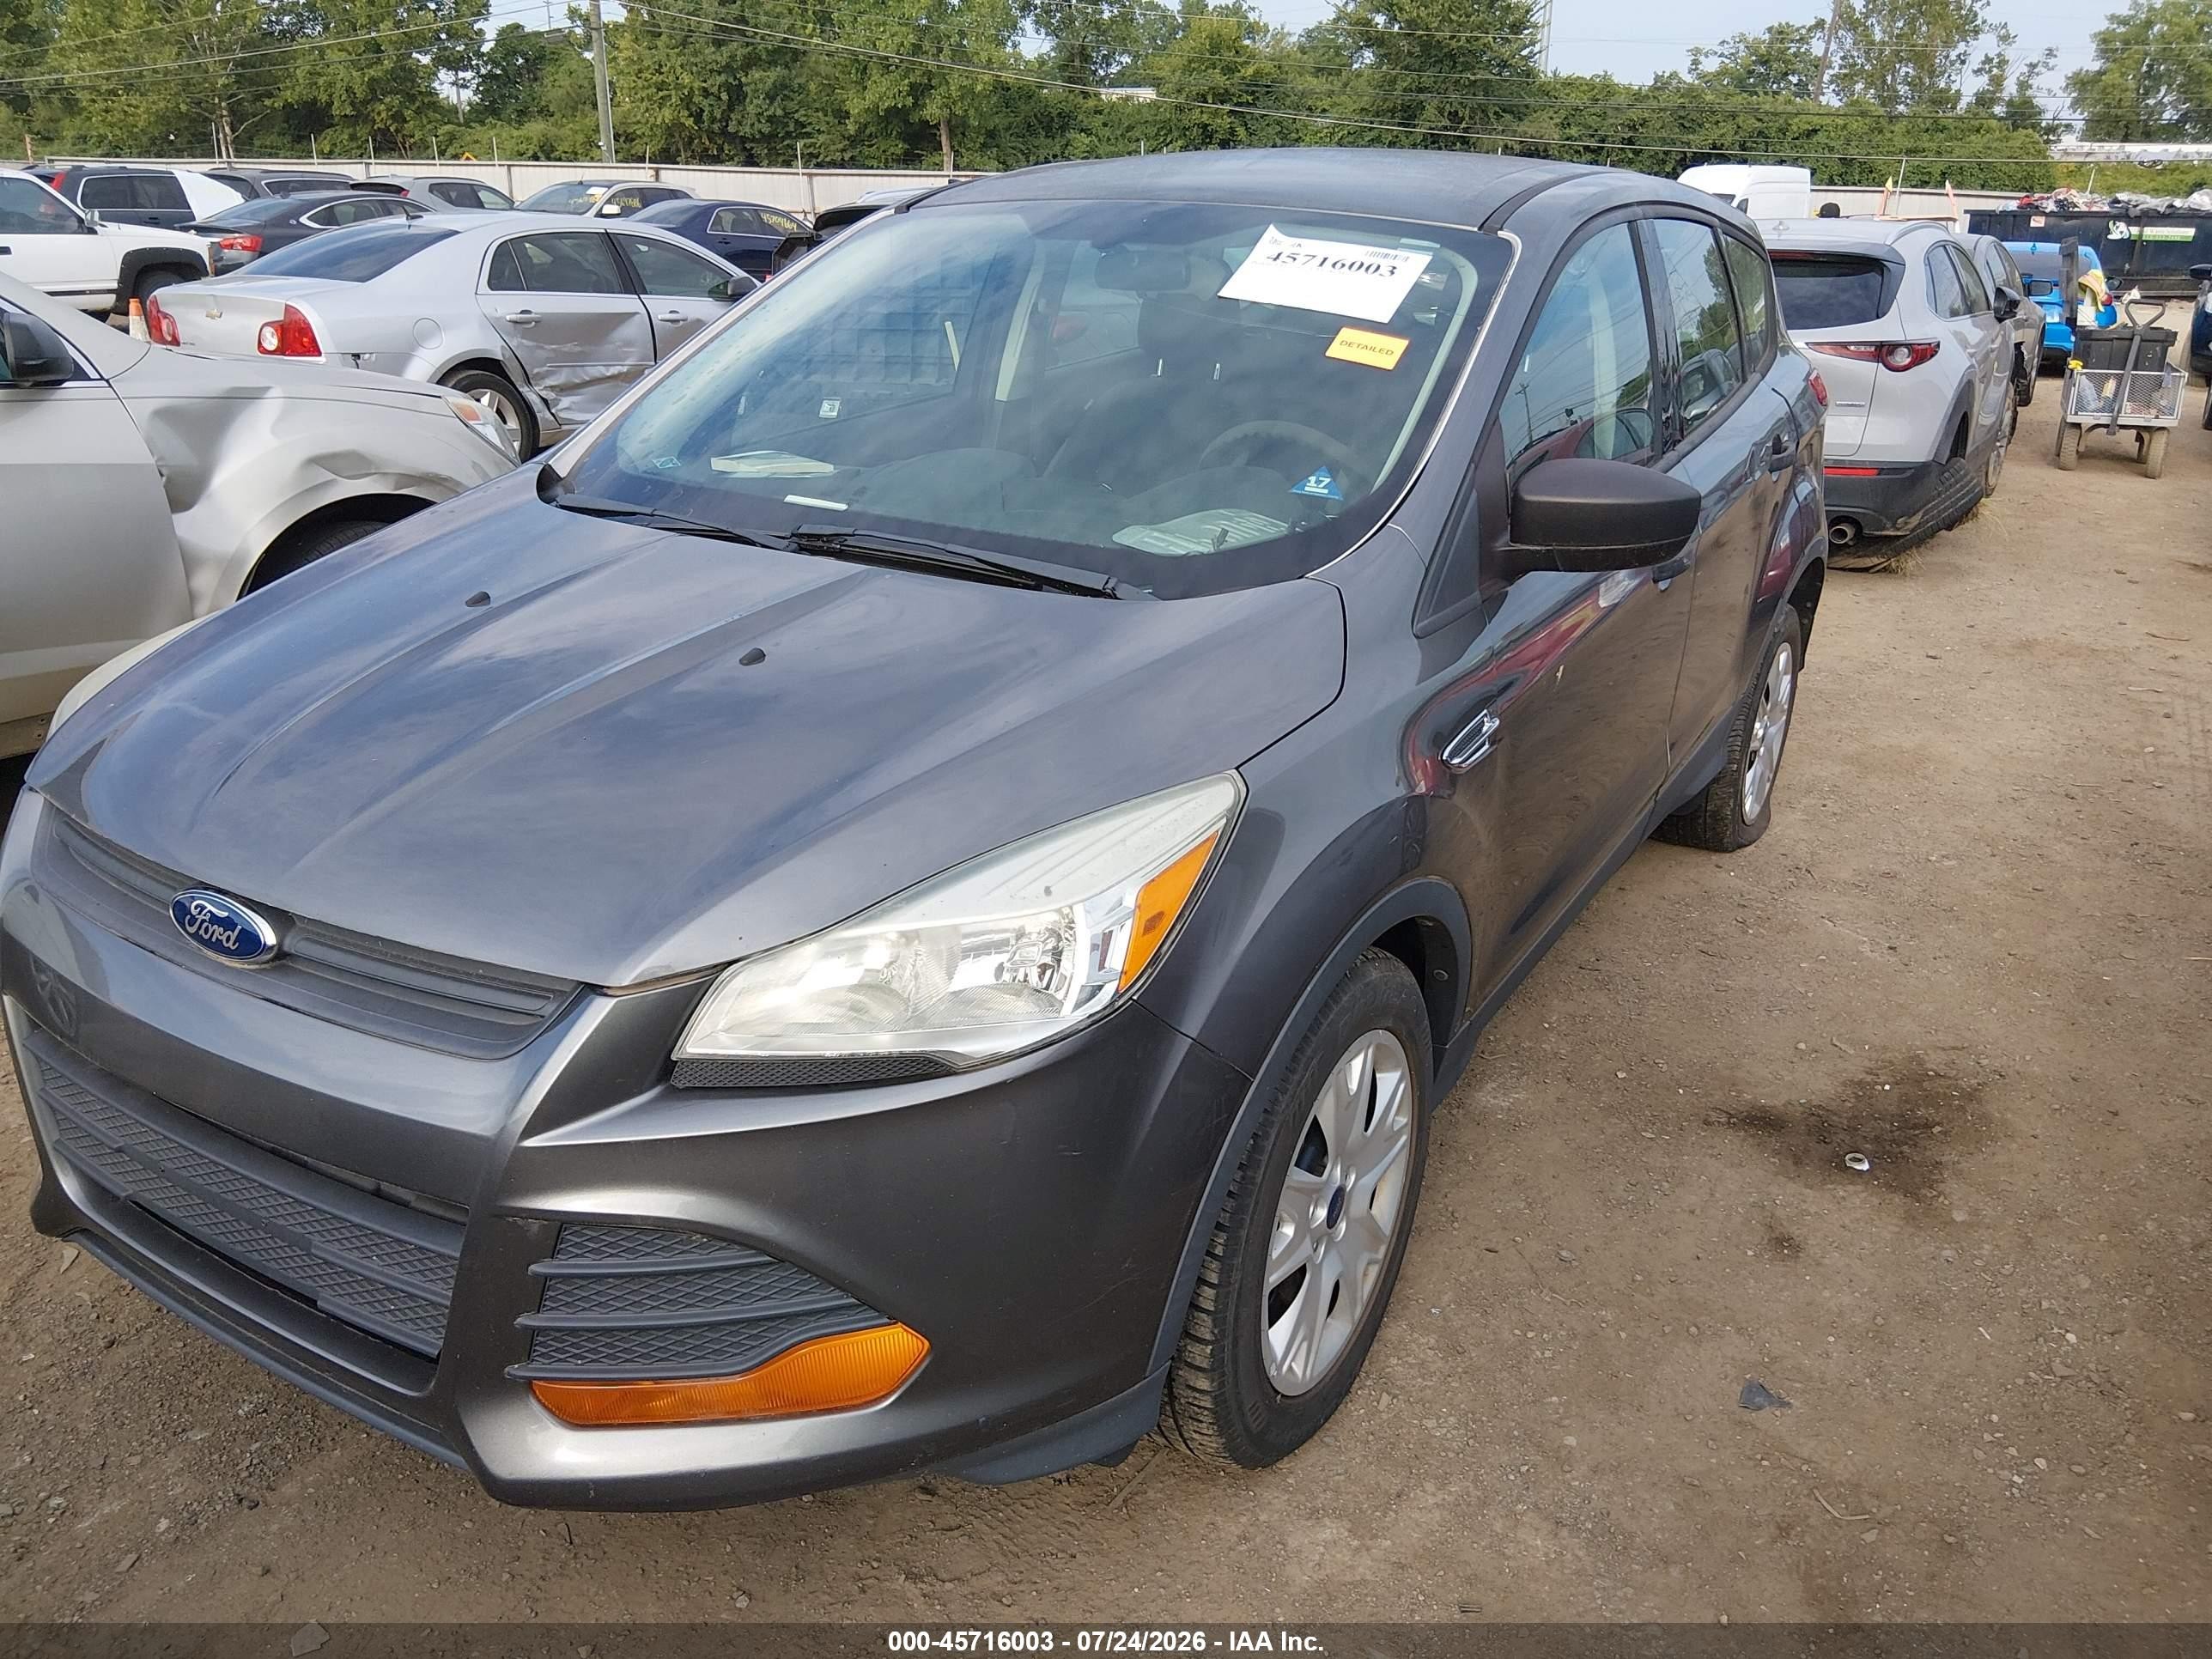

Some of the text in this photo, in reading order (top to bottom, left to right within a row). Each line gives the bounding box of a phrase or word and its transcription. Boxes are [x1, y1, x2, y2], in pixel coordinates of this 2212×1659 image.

[1267, 251, 1398, 277] 45716003
[1339, 339, 1395, 356] DETAILED
[1306, 476, 1331, 488] 17
[185, 900, 241, 950] Ford
